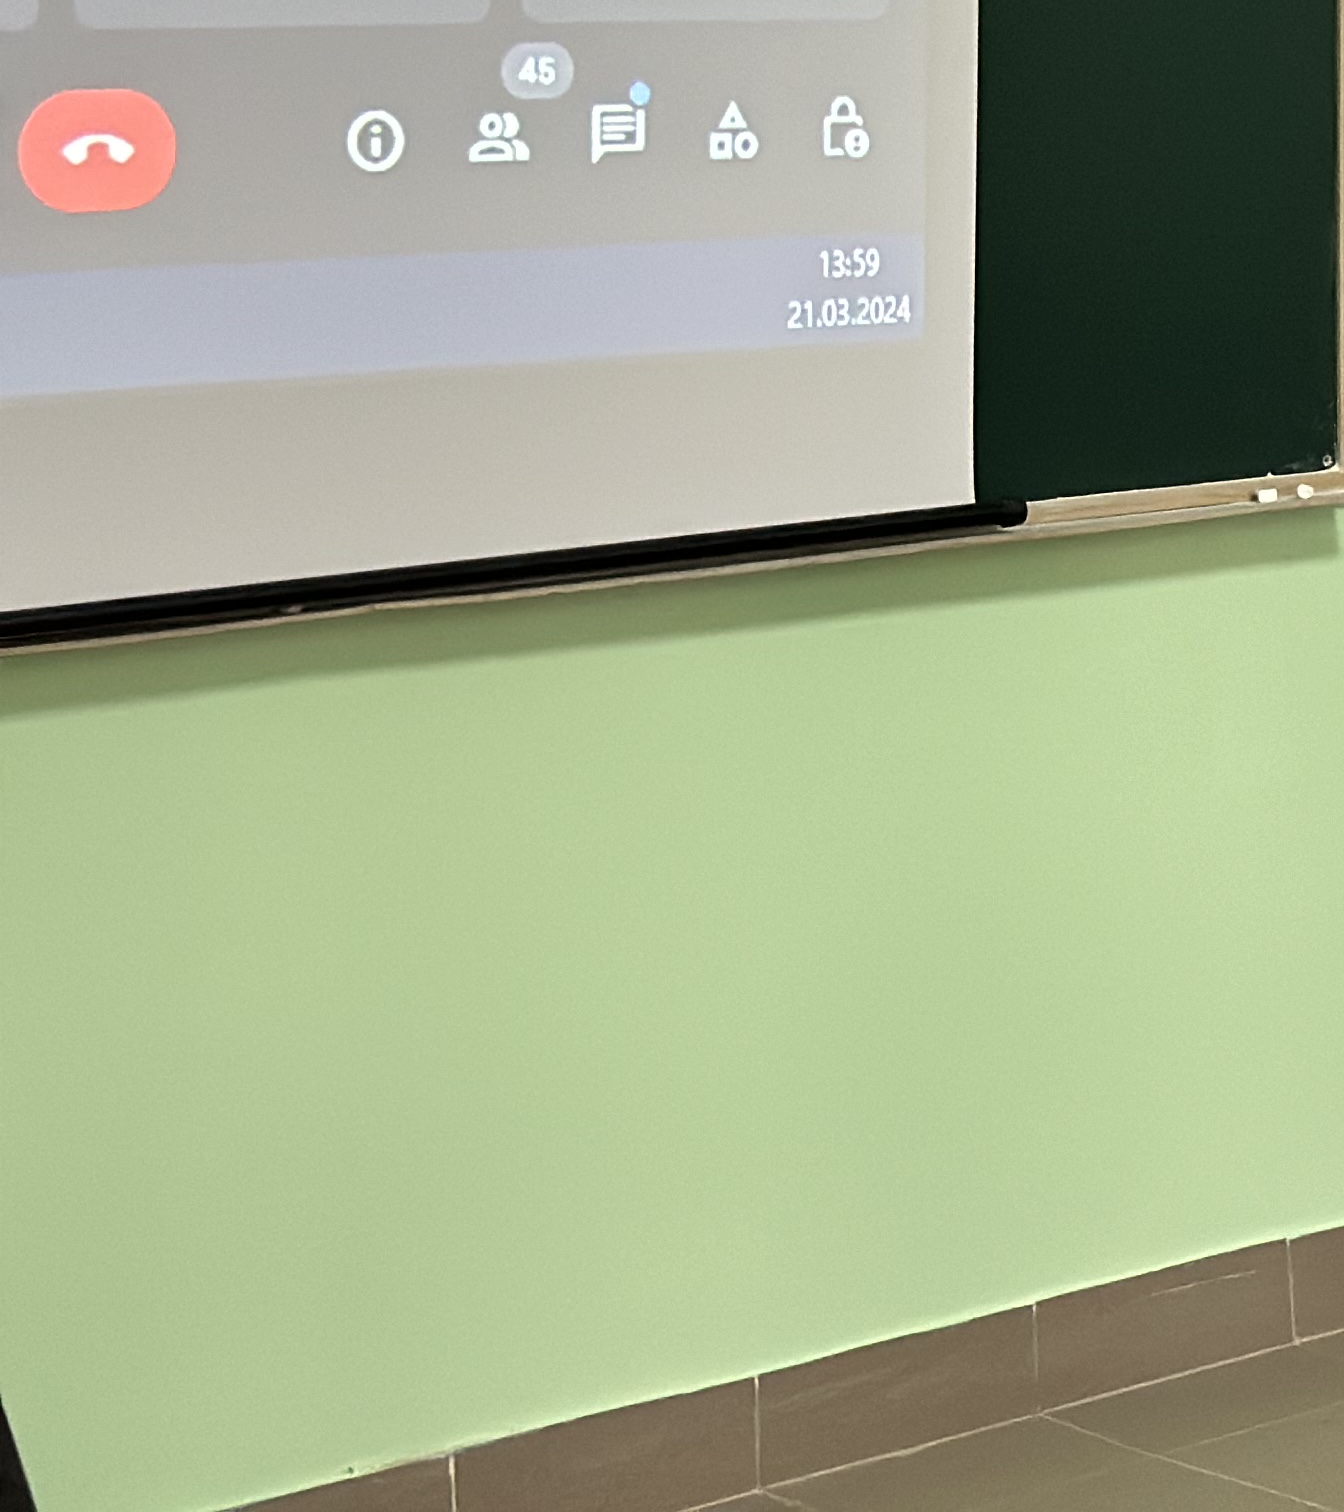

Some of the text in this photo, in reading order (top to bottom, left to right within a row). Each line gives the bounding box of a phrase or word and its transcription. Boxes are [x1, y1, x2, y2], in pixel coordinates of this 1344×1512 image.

[517, 55, 556, 86] 45
[819, 247, 881, 279] 13:59
[786, 294, 912, 329] 21.03.2024
